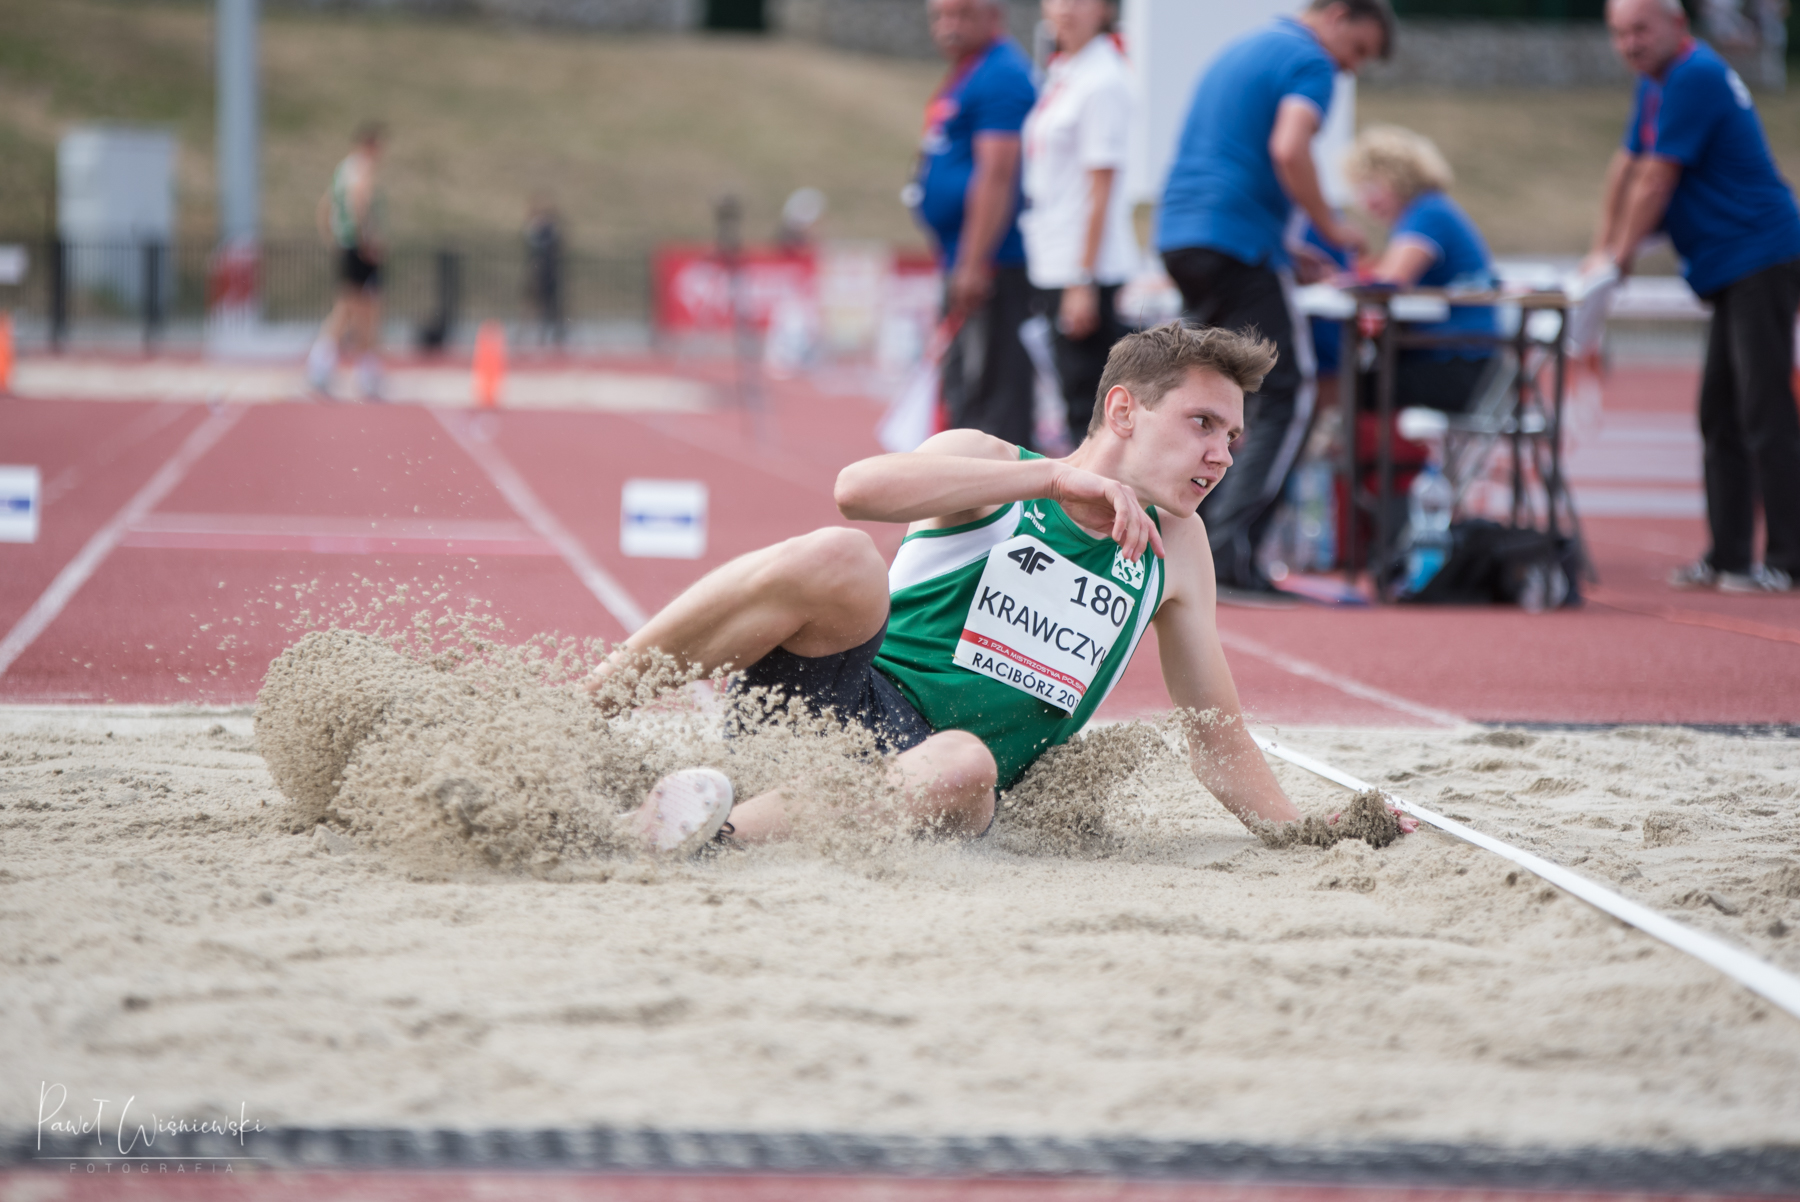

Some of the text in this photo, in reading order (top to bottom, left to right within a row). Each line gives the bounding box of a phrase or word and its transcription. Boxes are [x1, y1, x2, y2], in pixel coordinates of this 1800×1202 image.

[1007, 546, 1056, 576] 4F
[1070, 576, 1128, 628] 180
[972, 652, 1056, 699] RACIBÓRZ
[990, 642, 1010, 656] PZLA
[1010, 651, 1061, 680] MISTRZOSTWA
